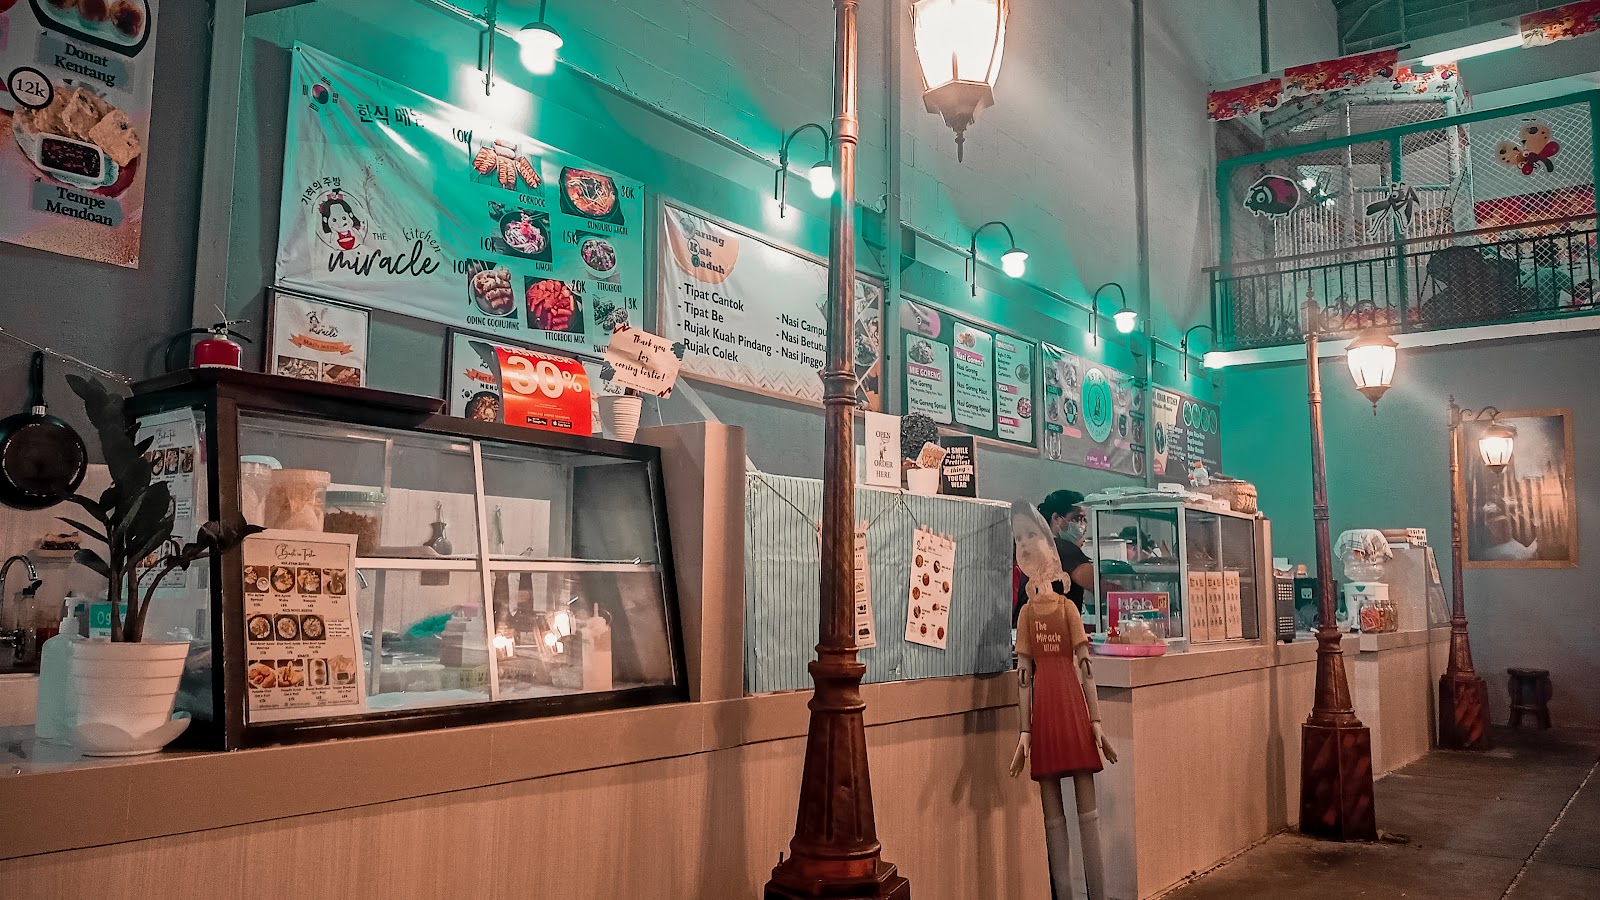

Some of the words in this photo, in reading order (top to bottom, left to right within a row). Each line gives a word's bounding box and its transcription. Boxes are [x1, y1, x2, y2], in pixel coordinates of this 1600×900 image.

[65, 42, 109, 68] Donat
[54, 55, 116, 87] Kentang
[16, 78, 47, 98] 12k
[356, 104, 390, 126] 한식
[452, 127, 469, 144] 10K
[56, 186, 106, 210] Tempe
[301, 180, 323, 206] 기적의
[322, 176, 342, 187] 주방
[621, 186, 635, 199] 30K
[46, 200, 114, 227] Mendoan
[372, 232, 388, 240] THE
[402, 227, 442, 253] kitchen
[328, 240, 440, 277] miracle
[684, 283, 710, 301] Tipat
[712, 292, 744, 312] Cantok
[684, 302, 709, 320] Tipat
[711, 308, 724, 323] Be
[782, 314, 798, 328] Nasi
[801, 320, 827, 338] Campu
[574, 333, 585, 343] MIX
[634, 334, 652, 347] Thank
[654, 344, 666, 353] you
[684, 320, 710, 338] Rujak
[712, 328, 736, 344] Kuah
[738, 335, 772, 356] Pindang
[782, 330, 798, 344] Nasi
[638, 350, 649, 362] for
[684, 338, 710, 356] Rujak
[712, 346, 739, 363] Colek
[782, 346, 798, 360] Nasi
[800, 352, 824, 369] Jinggo
[507, 356, 583, 399] 30%
[910, 366, 920, 376] MIE
[920, 368, 941, 380] GORENG
[480, 383, 498, 391] MENU
[876, 430, 891, 439] OPEN
[874, 460, 894, 469] ORDER
[876, 470, 891, 478] HERE
[1034, 621, 1047, 631] The
[1036, 633, 1061, 643] Miracle
